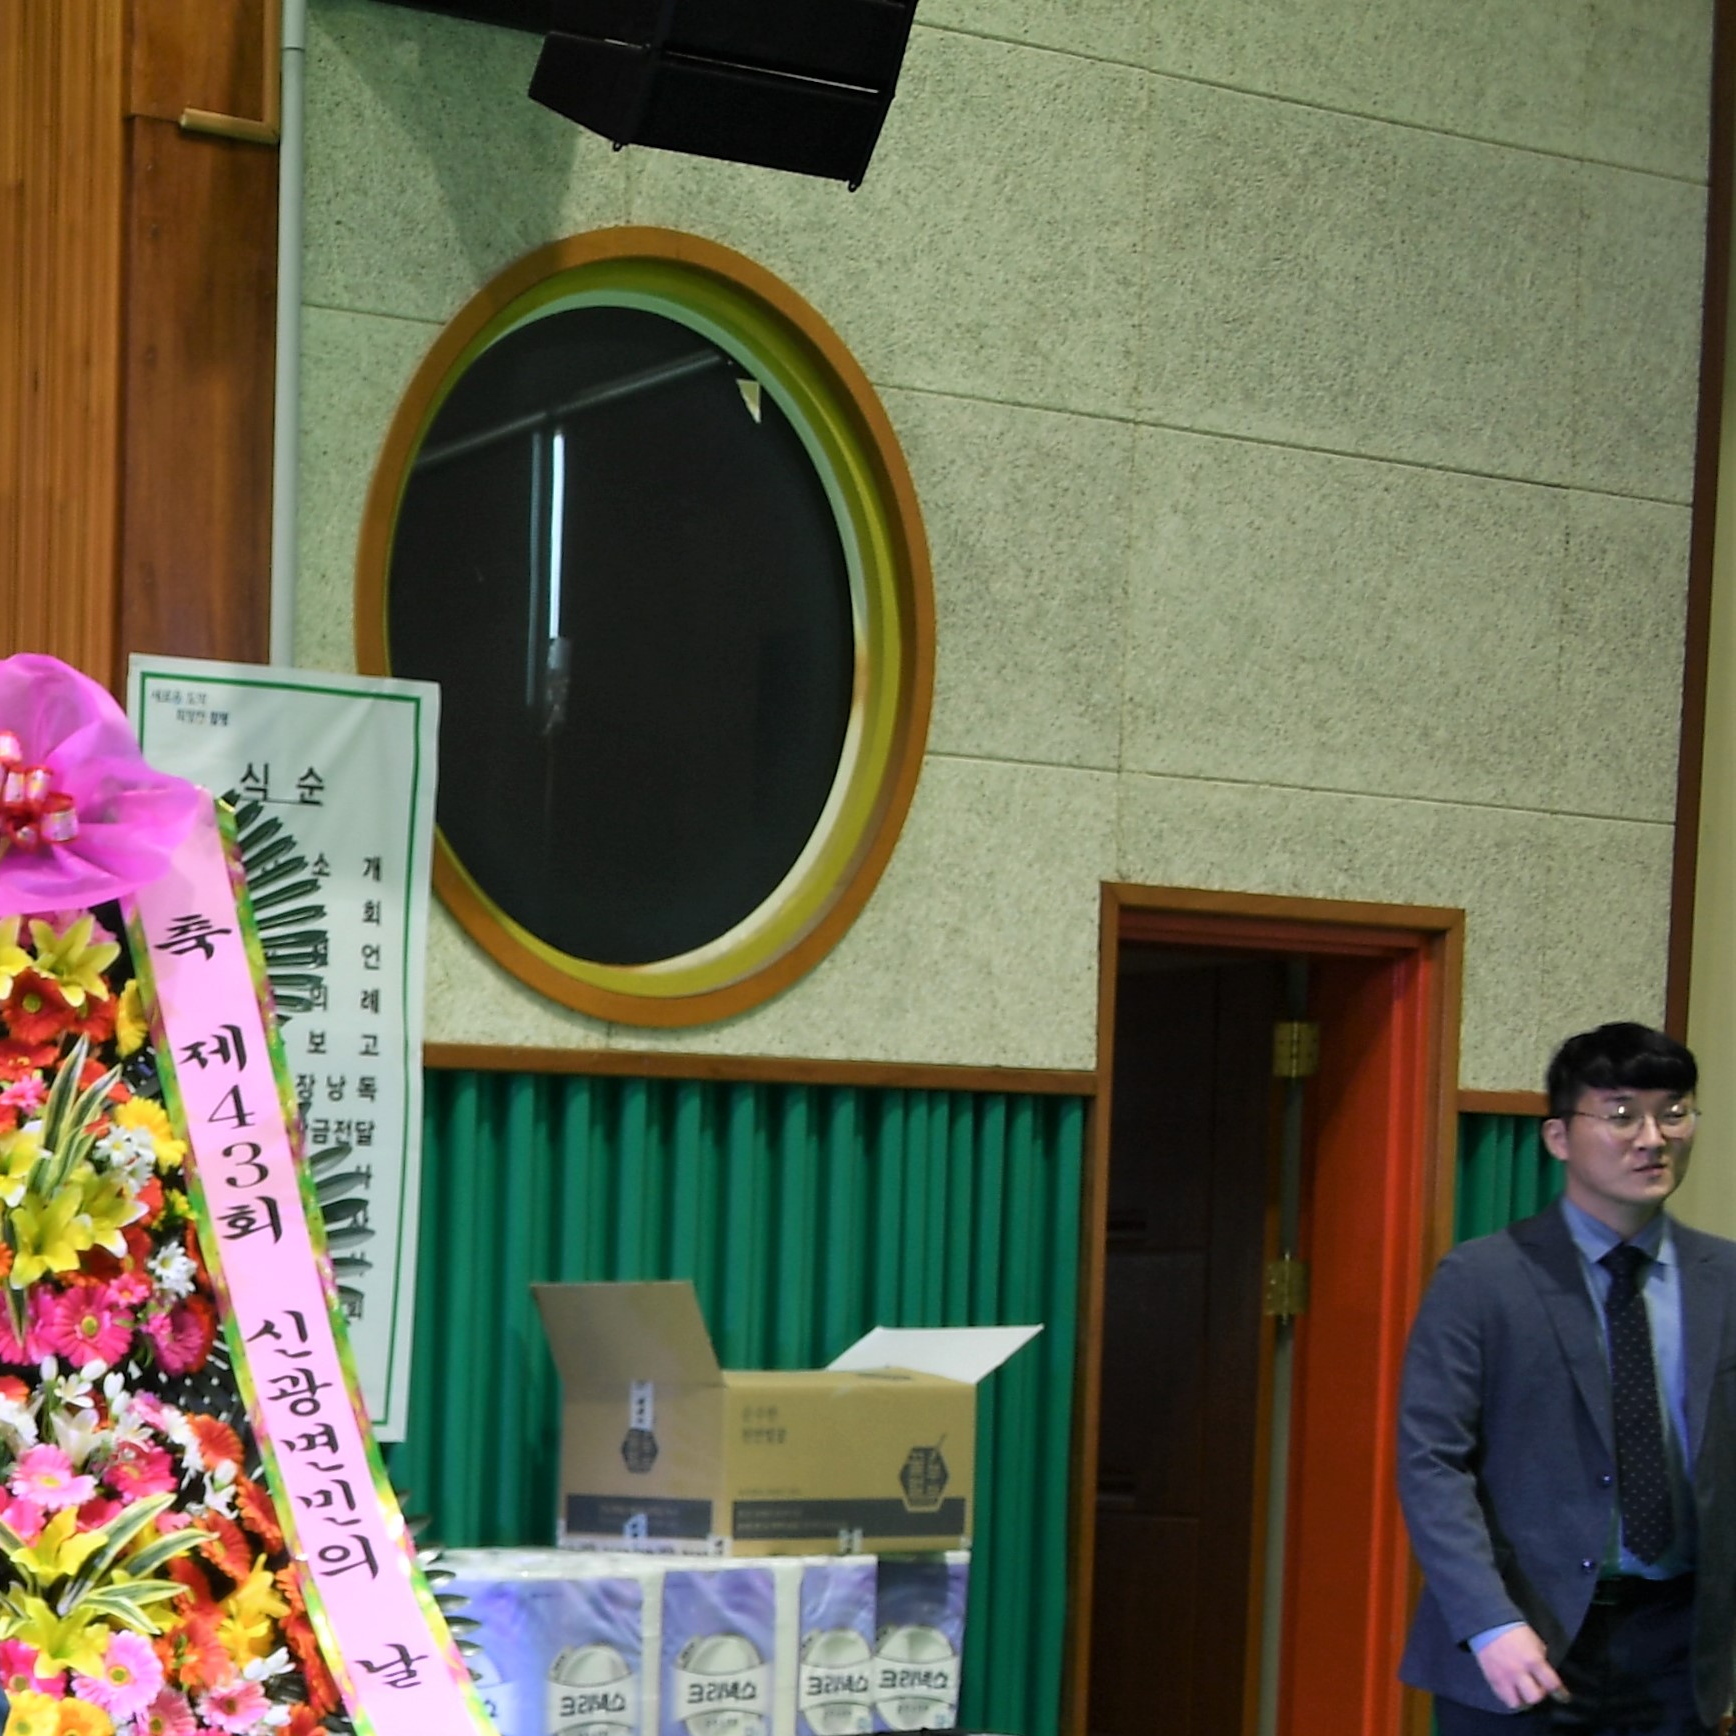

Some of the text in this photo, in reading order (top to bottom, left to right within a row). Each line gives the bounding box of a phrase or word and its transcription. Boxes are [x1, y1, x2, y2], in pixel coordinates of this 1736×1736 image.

[154, 912, 233, 962] 축
[178, 1024, 286, 1245] 제43회
[245, 1309, 380, 1581] 신광면민의
[356, 1642, 430, 1690] 날
[879, 1669, 949, 1690] 크리넥스
[559, 1693, 627, 1718] 크리넥스
[687, 1681, 758, 1704] 크리넥스
